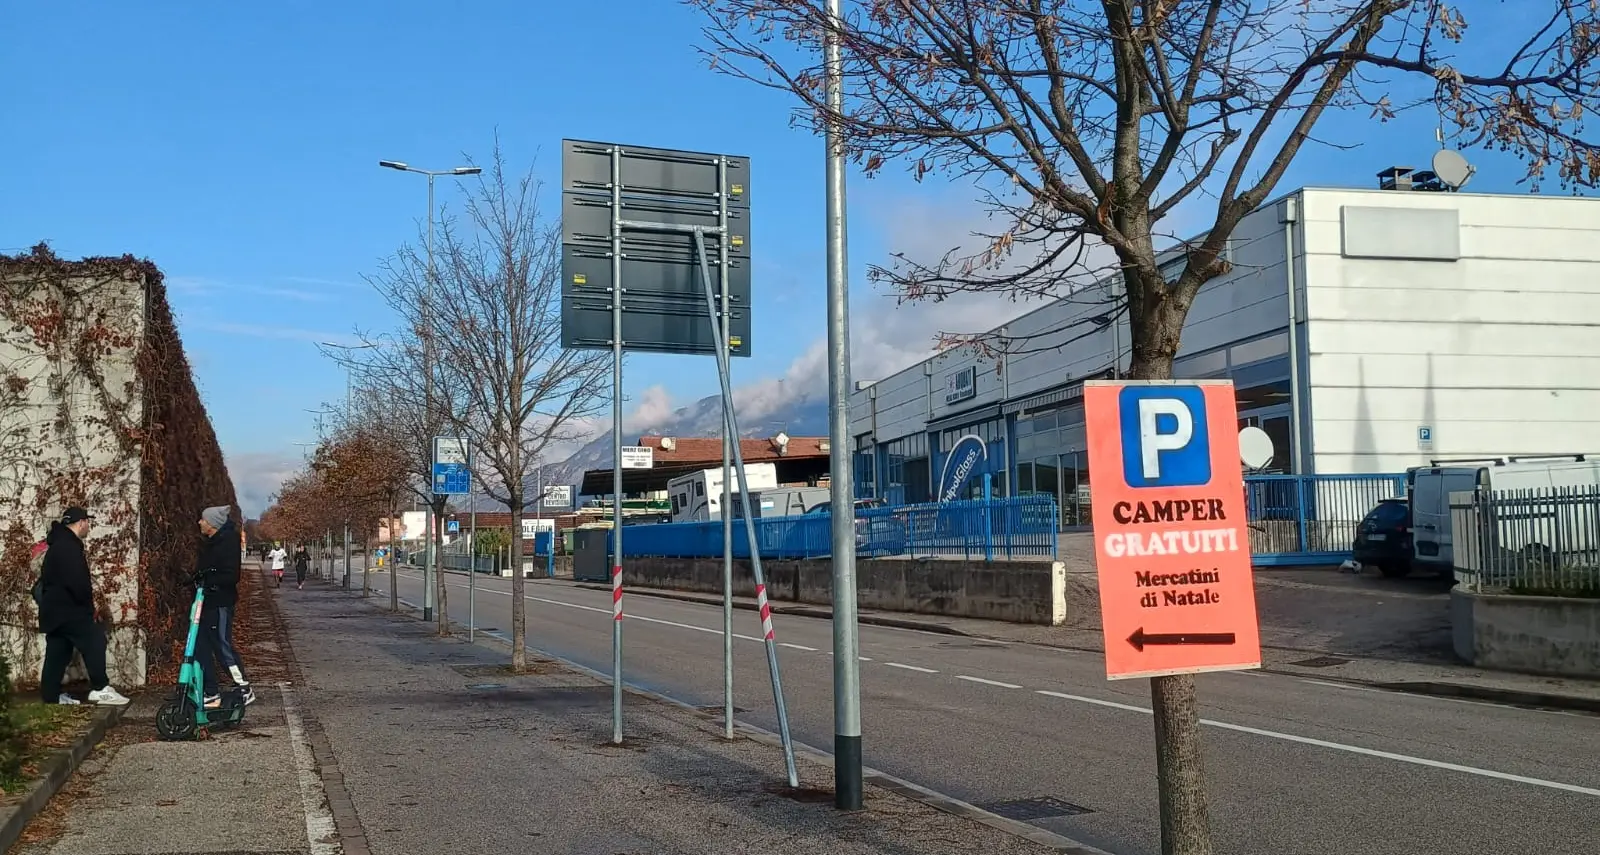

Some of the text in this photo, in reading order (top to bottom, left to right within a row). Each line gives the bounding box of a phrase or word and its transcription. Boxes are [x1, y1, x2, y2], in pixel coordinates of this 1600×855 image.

[1138, 398, 1193, 479] P
[1421, 429, 1429, 439] P
[1113, 498, 1227, 524] CAMPER
[1104, 528, 1239, 558] GRATUITI
[1135, 568, 1220, 587] Mercatini
[1140, 589, 1220, 608] di Natale
